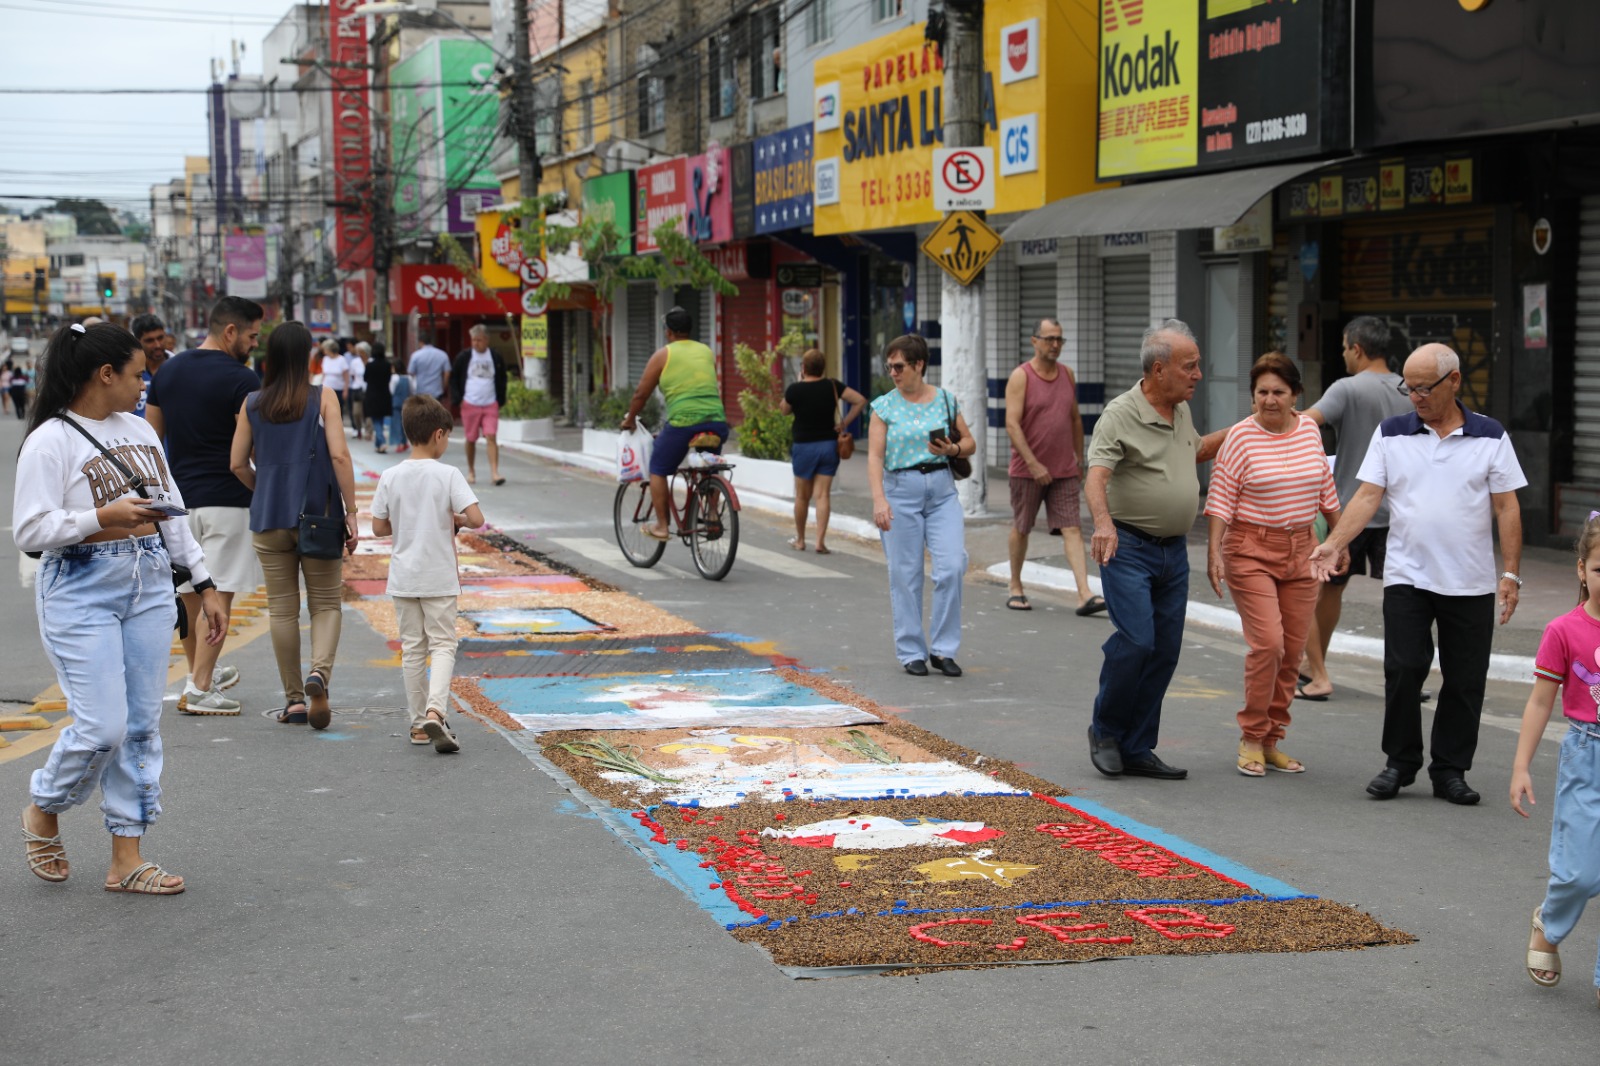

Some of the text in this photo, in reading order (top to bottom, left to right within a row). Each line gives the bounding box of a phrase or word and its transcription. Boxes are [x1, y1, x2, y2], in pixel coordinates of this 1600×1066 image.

[1104, 29, 1180, 99] Kodak
[843, 71, 998, 163] SANTA LUA
[1115, 95, 1190, 137] EXPRESS
[956, 160, 970, 184] E
[861, 181, 891, 206] TEL:
[1447, 184, 1469, 194] Kodak
[436, 276, 475, 301] 24h
[523, 327, 547, 341] OURO
